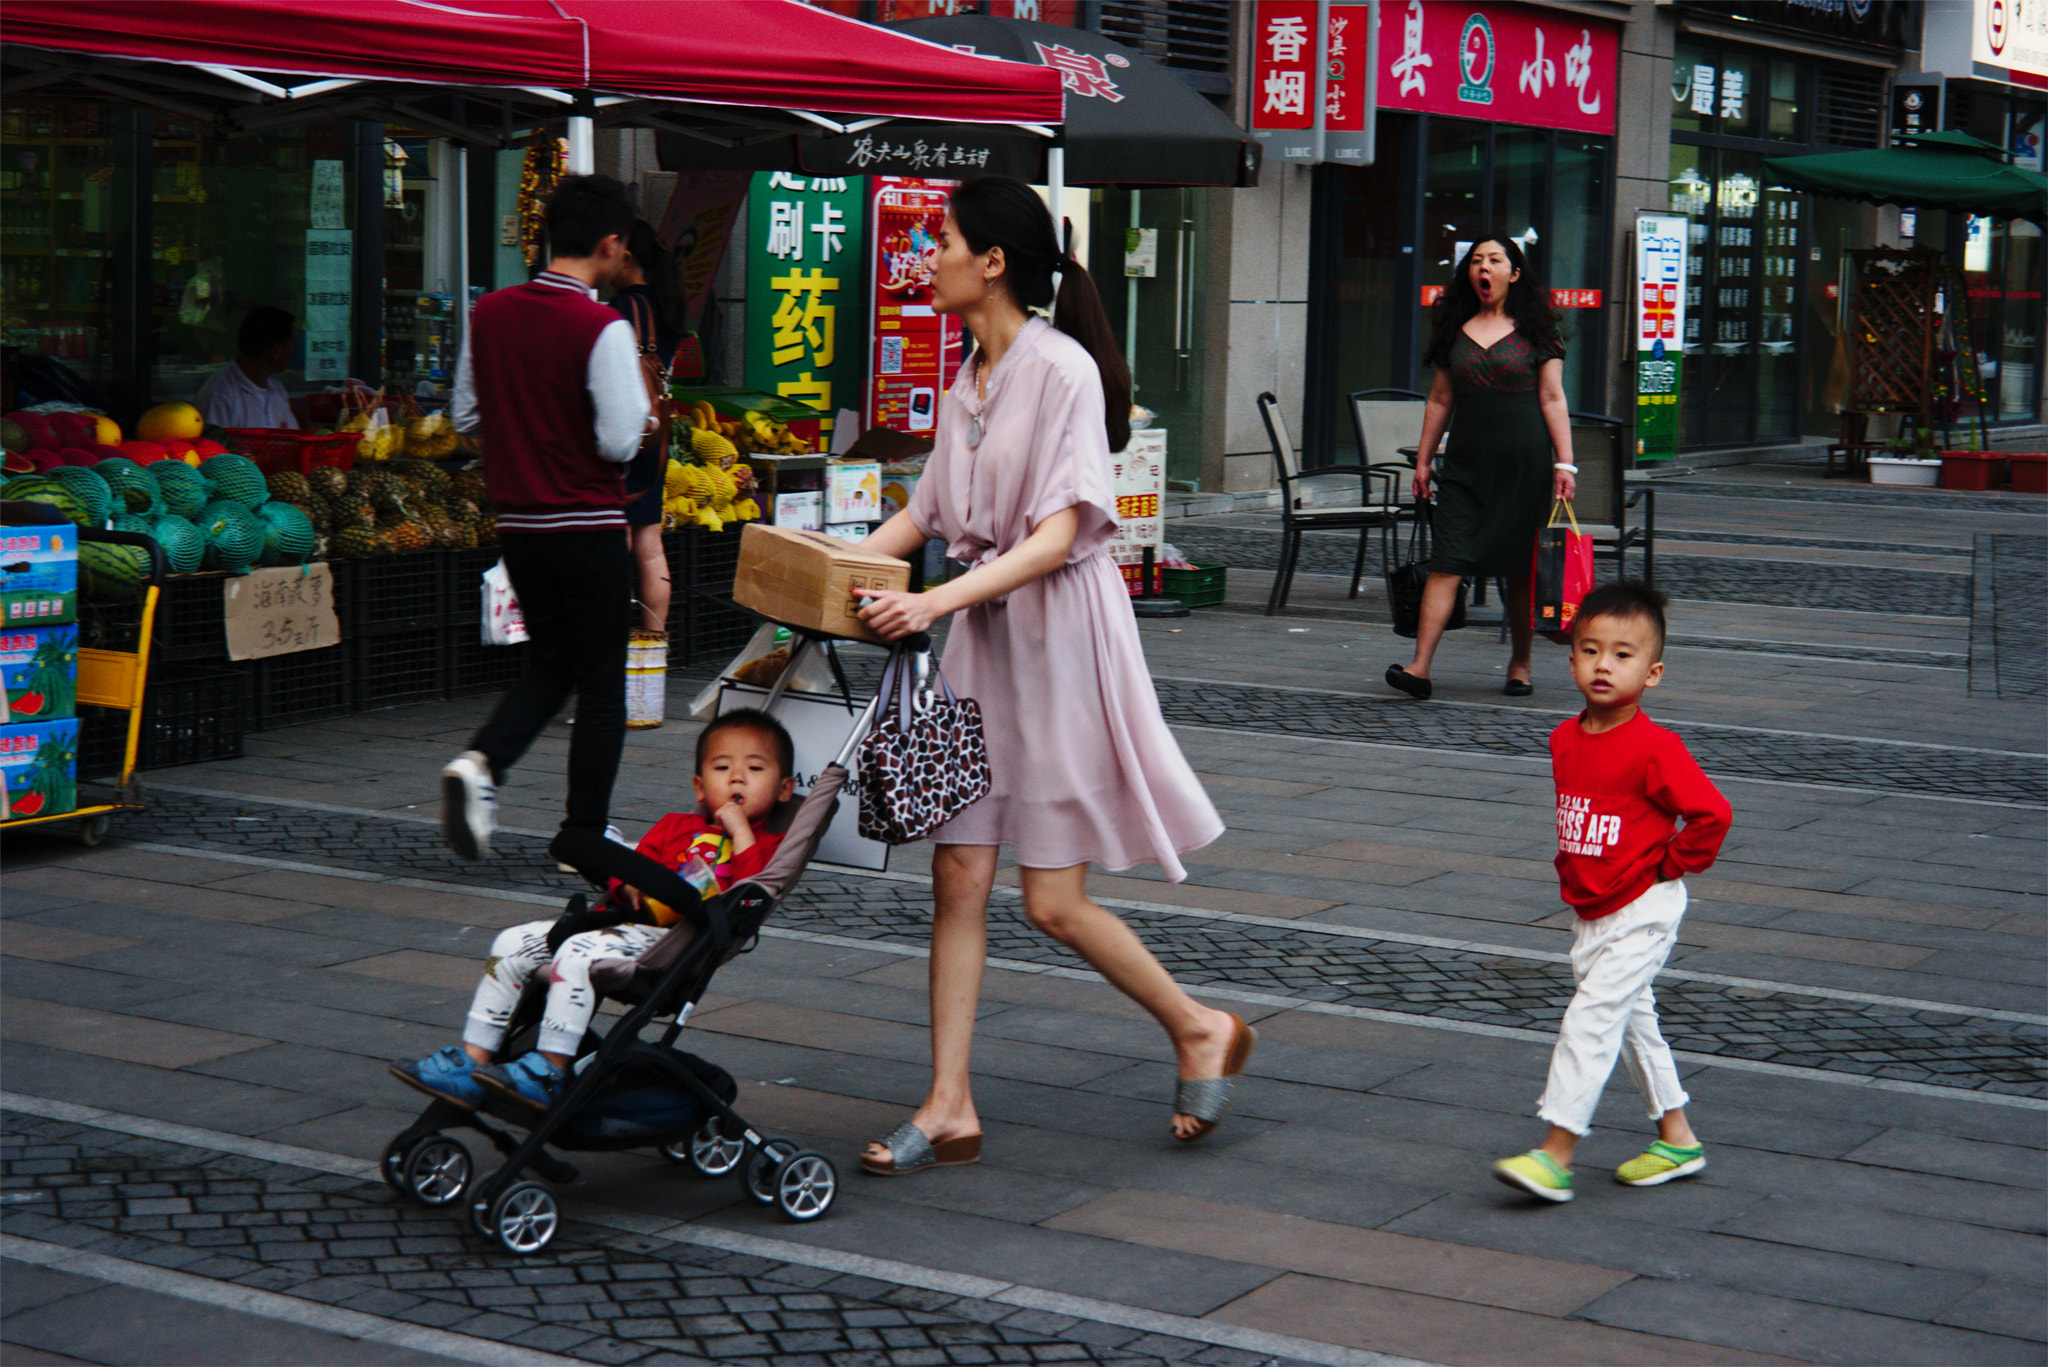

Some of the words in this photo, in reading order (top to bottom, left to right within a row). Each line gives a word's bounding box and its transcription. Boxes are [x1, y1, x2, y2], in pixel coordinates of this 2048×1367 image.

[1329, 17, 1349, 56] 沙县
[1377, 0, 1433, 98] 县
[1519, 27, 1601, 115] 小吃
[1263, 16, 1308, 115] 香烟
[1326, 84, 1347, 121] 小吃
[1691, 64, 1744, 120] 最美
[846, 132, 992, 171] 农夫山泉有点甜
[767, 201, 847, 263] 刷卡
[1585, 813, 1622, 846] AFB
